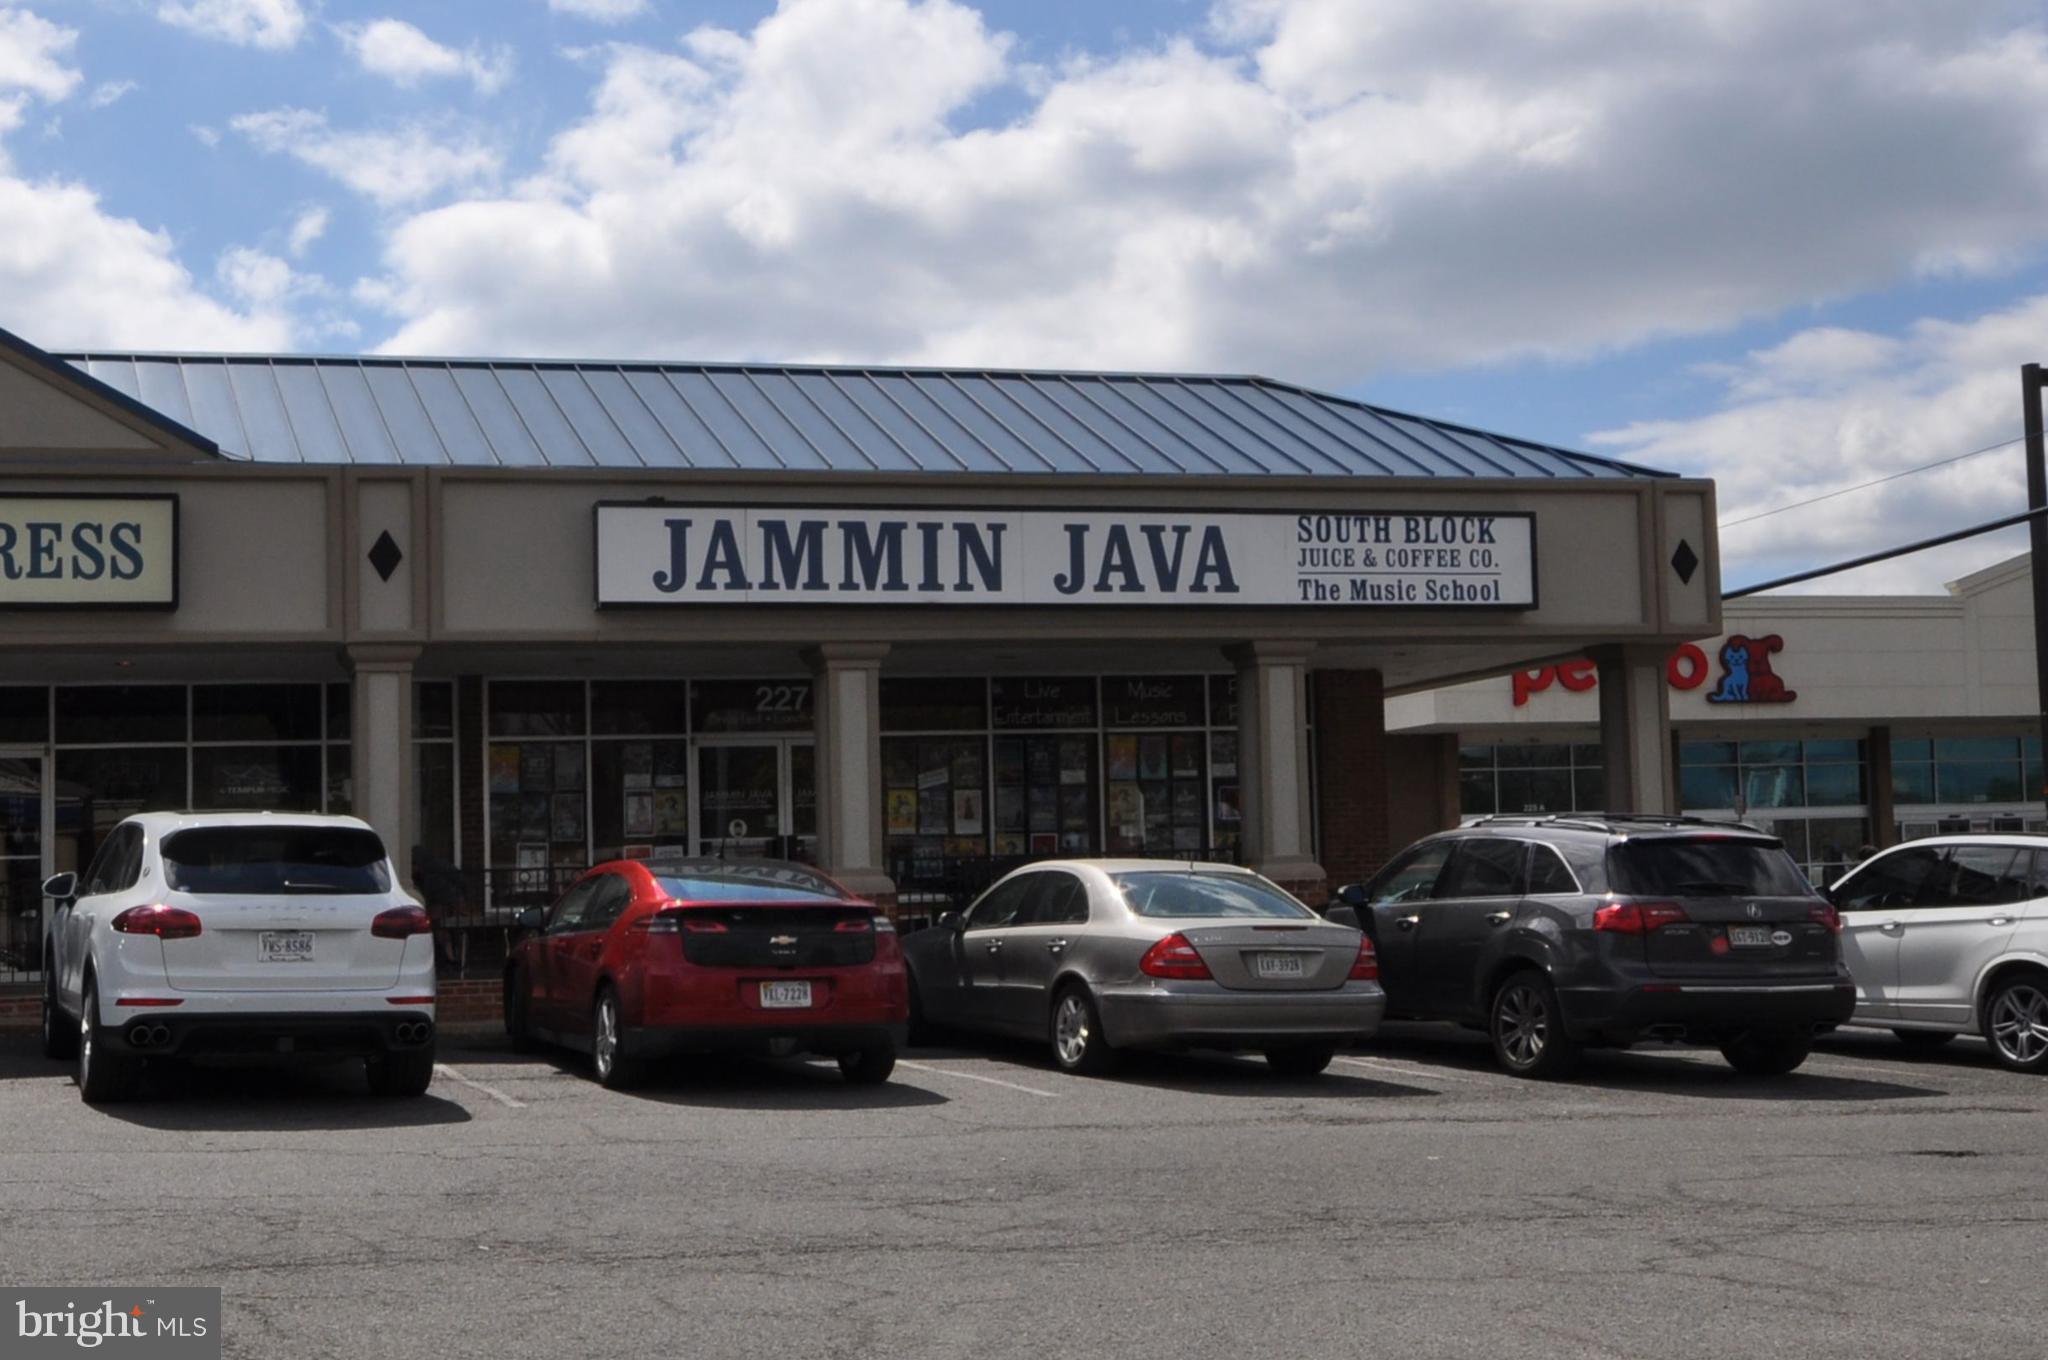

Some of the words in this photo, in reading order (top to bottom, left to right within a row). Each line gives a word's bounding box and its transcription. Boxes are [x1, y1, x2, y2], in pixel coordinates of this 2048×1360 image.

[1297, 515, 1392, 543] SOUTH
[1403, 516, 1496, 544] BLOCK
[652, 518, 1007, 593] JAMMIN
[1053, 523, 1240, 595] JAVA
[1297, 548, 1355, 568] JUICE
[1363, 548, 1378, 568] &
[1385, 549, 1462, 568] COFFEE
[1468, 549, 1499, 568] CO.
[1297, 578, 1341, 602] The
[1350, 579, 1417, 602] Music
[1425, 579, 1501, 602] School
[755, 685, 809, 712] 227
[1024, 680, 1062, 699] Live
[1127, 680, 1173, 704] Music
[1114, 705, 1187, 725] Lessons
